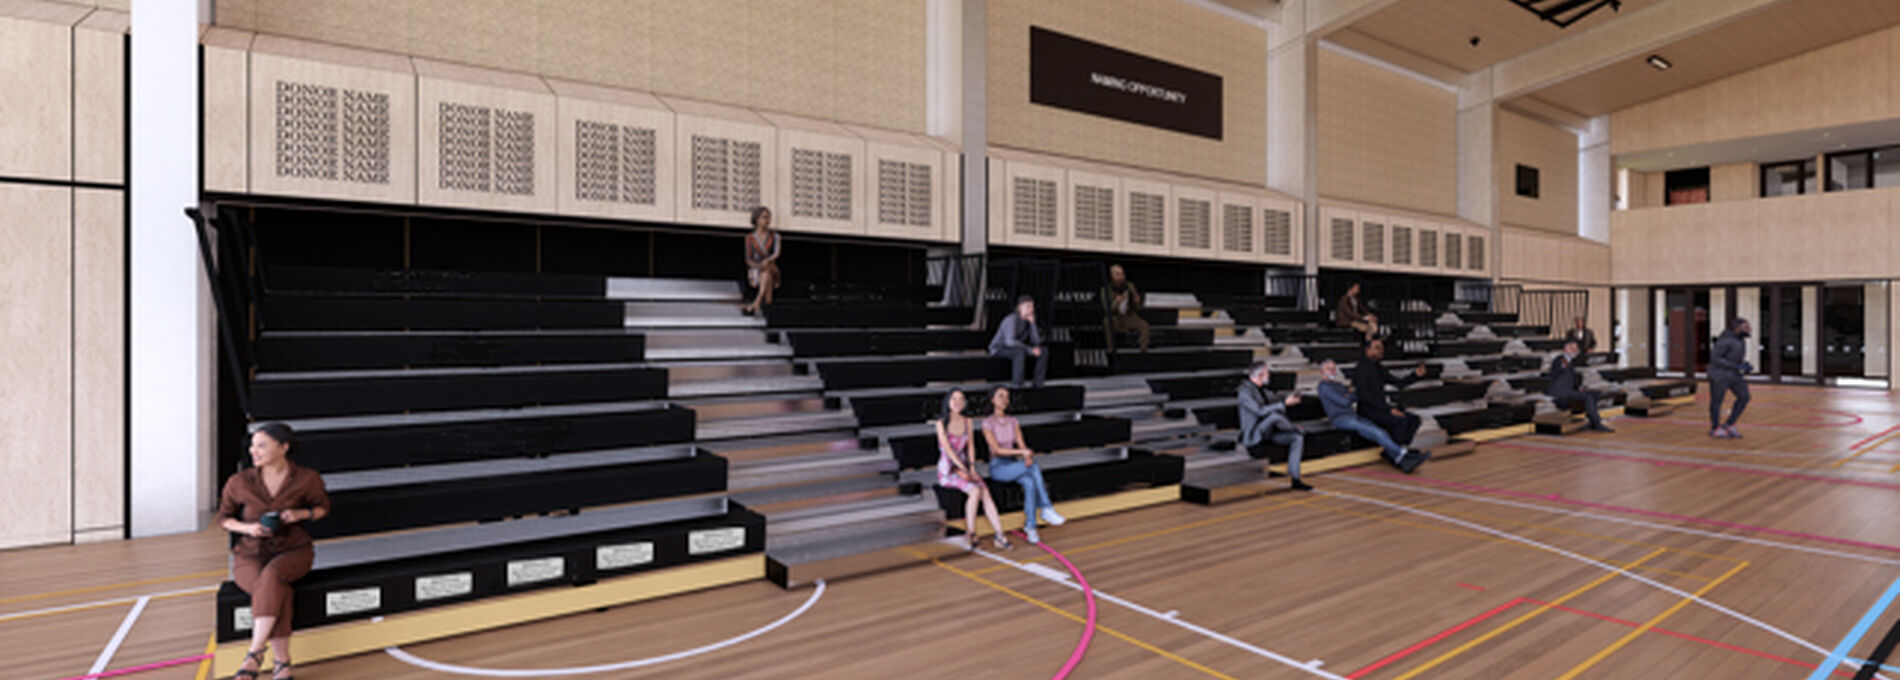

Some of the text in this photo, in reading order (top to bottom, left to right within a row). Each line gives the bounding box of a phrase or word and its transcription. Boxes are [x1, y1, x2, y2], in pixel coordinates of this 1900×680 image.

[276, 81, 390, 105] DONOR NAME
[1127, 81, 1187, 104] OPPORTUNITY
[276, 93, 390, 117] DONOR NAME
[276, 105, 390, 128] DONOR NAME
[276, 117, 390, 140] DONOR NAME
[276, 129, 390, 151] DONOR NAME
[276, 141, 390, 162] DONOR NAME
[276, 153, 390, 174] DONOR NAME
[276, 165, 390, 185] DONOR NAME
